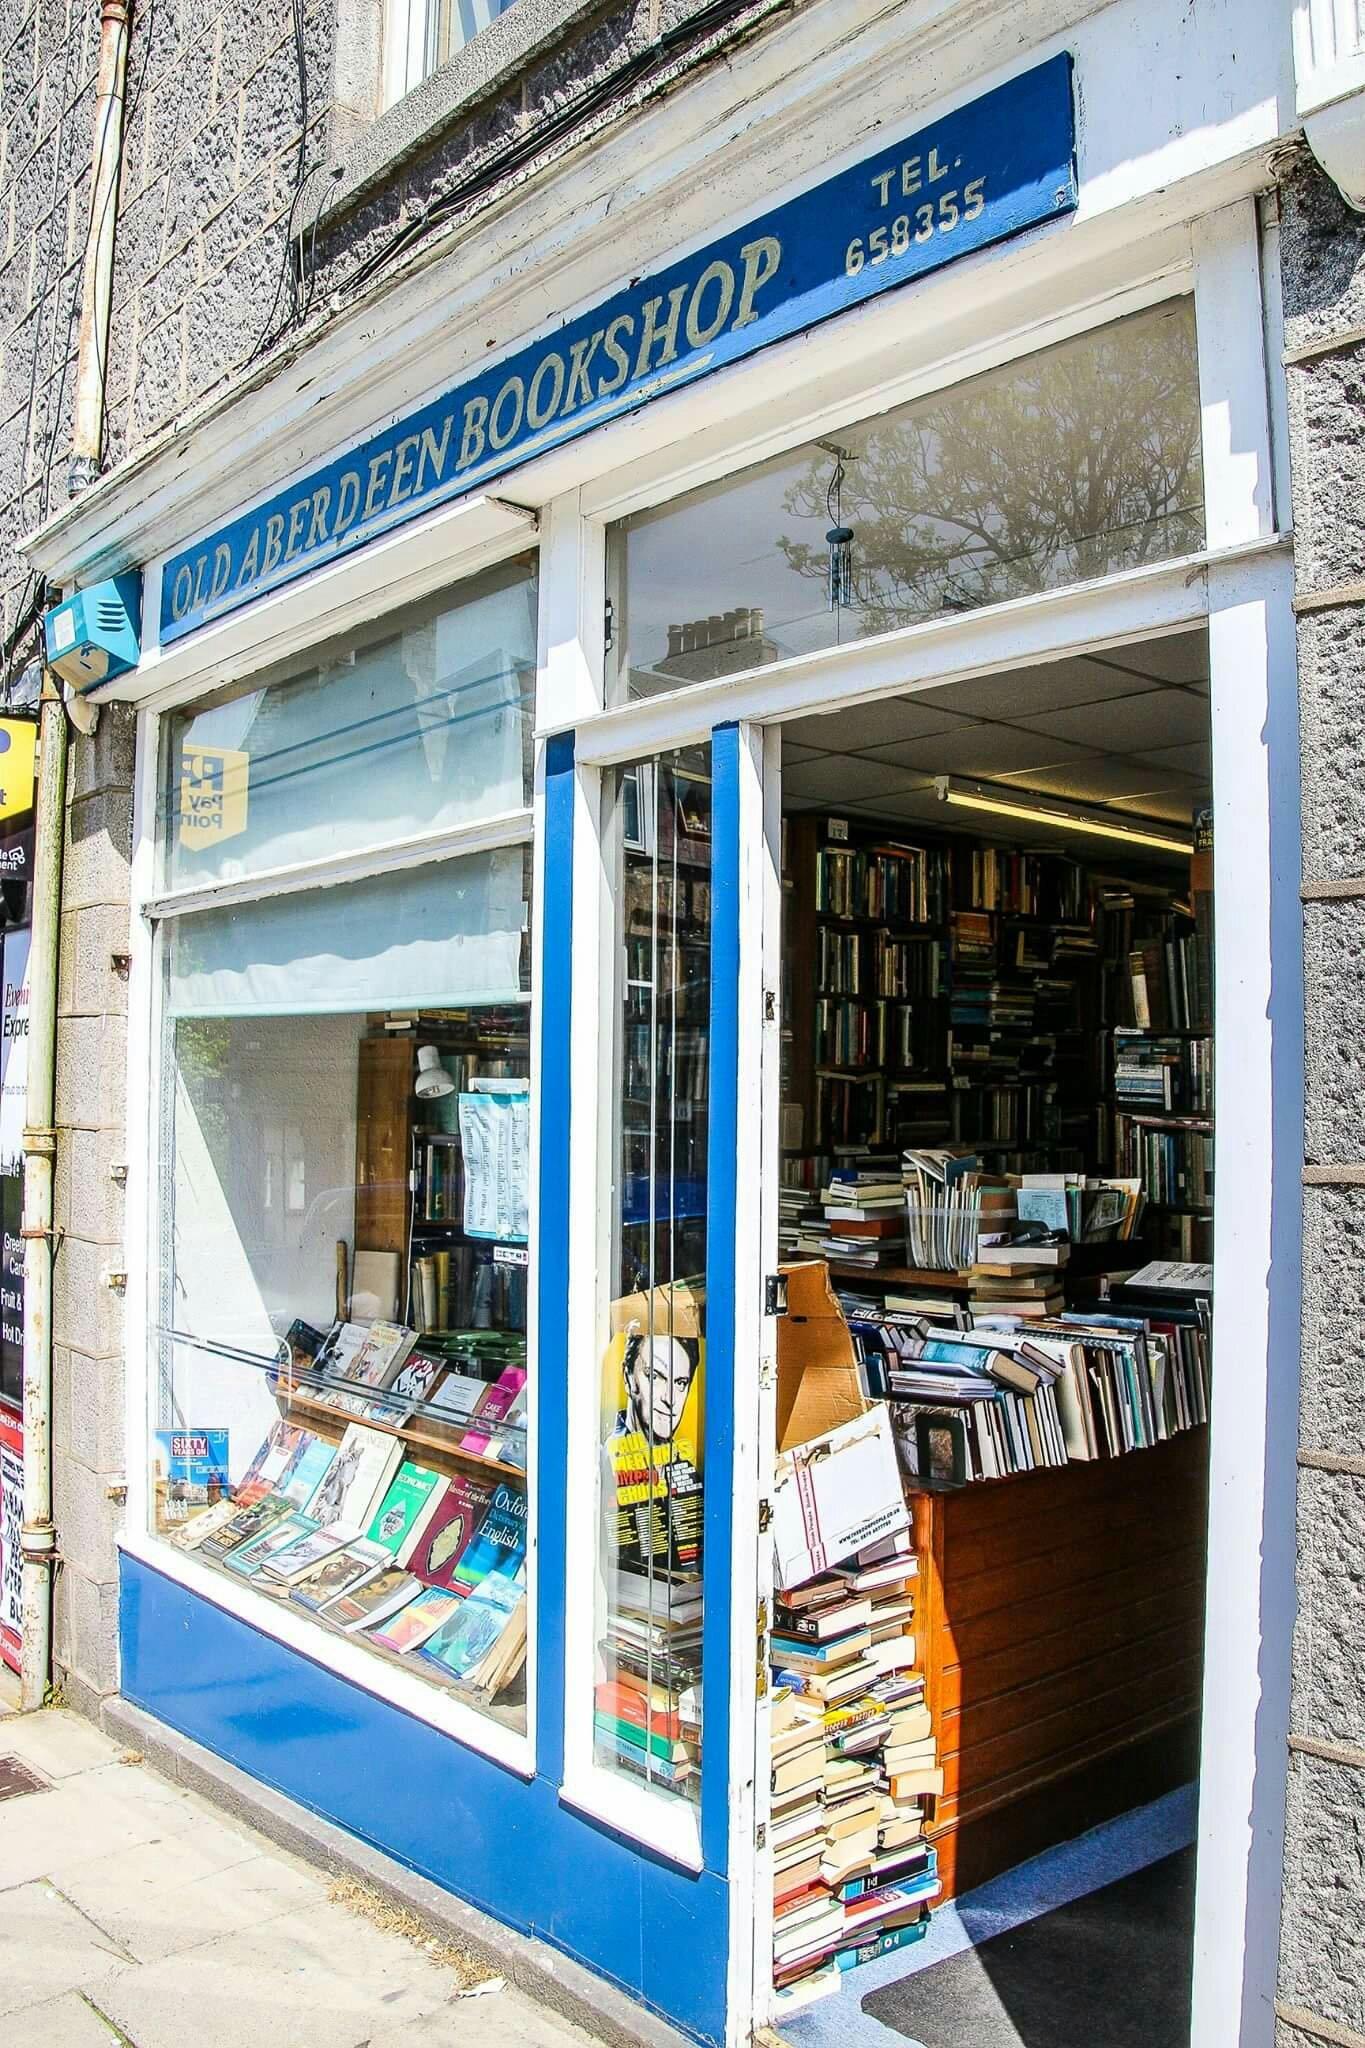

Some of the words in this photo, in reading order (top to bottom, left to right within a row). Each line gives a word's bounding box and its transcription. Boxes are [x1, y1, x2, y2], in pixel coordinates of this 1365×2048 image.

[871, 147, 962, 208] TEL.
[846, 175, 987, 277] 658355
[172, 554, 232, 623] OLD
[238, 416, 453, 586] ABERDEEN
[455, 236, 783, 472] BOOKSHOP
[173, 1437, 207, 1449] SIXTY
[479, 1520, 519, 1550] English
